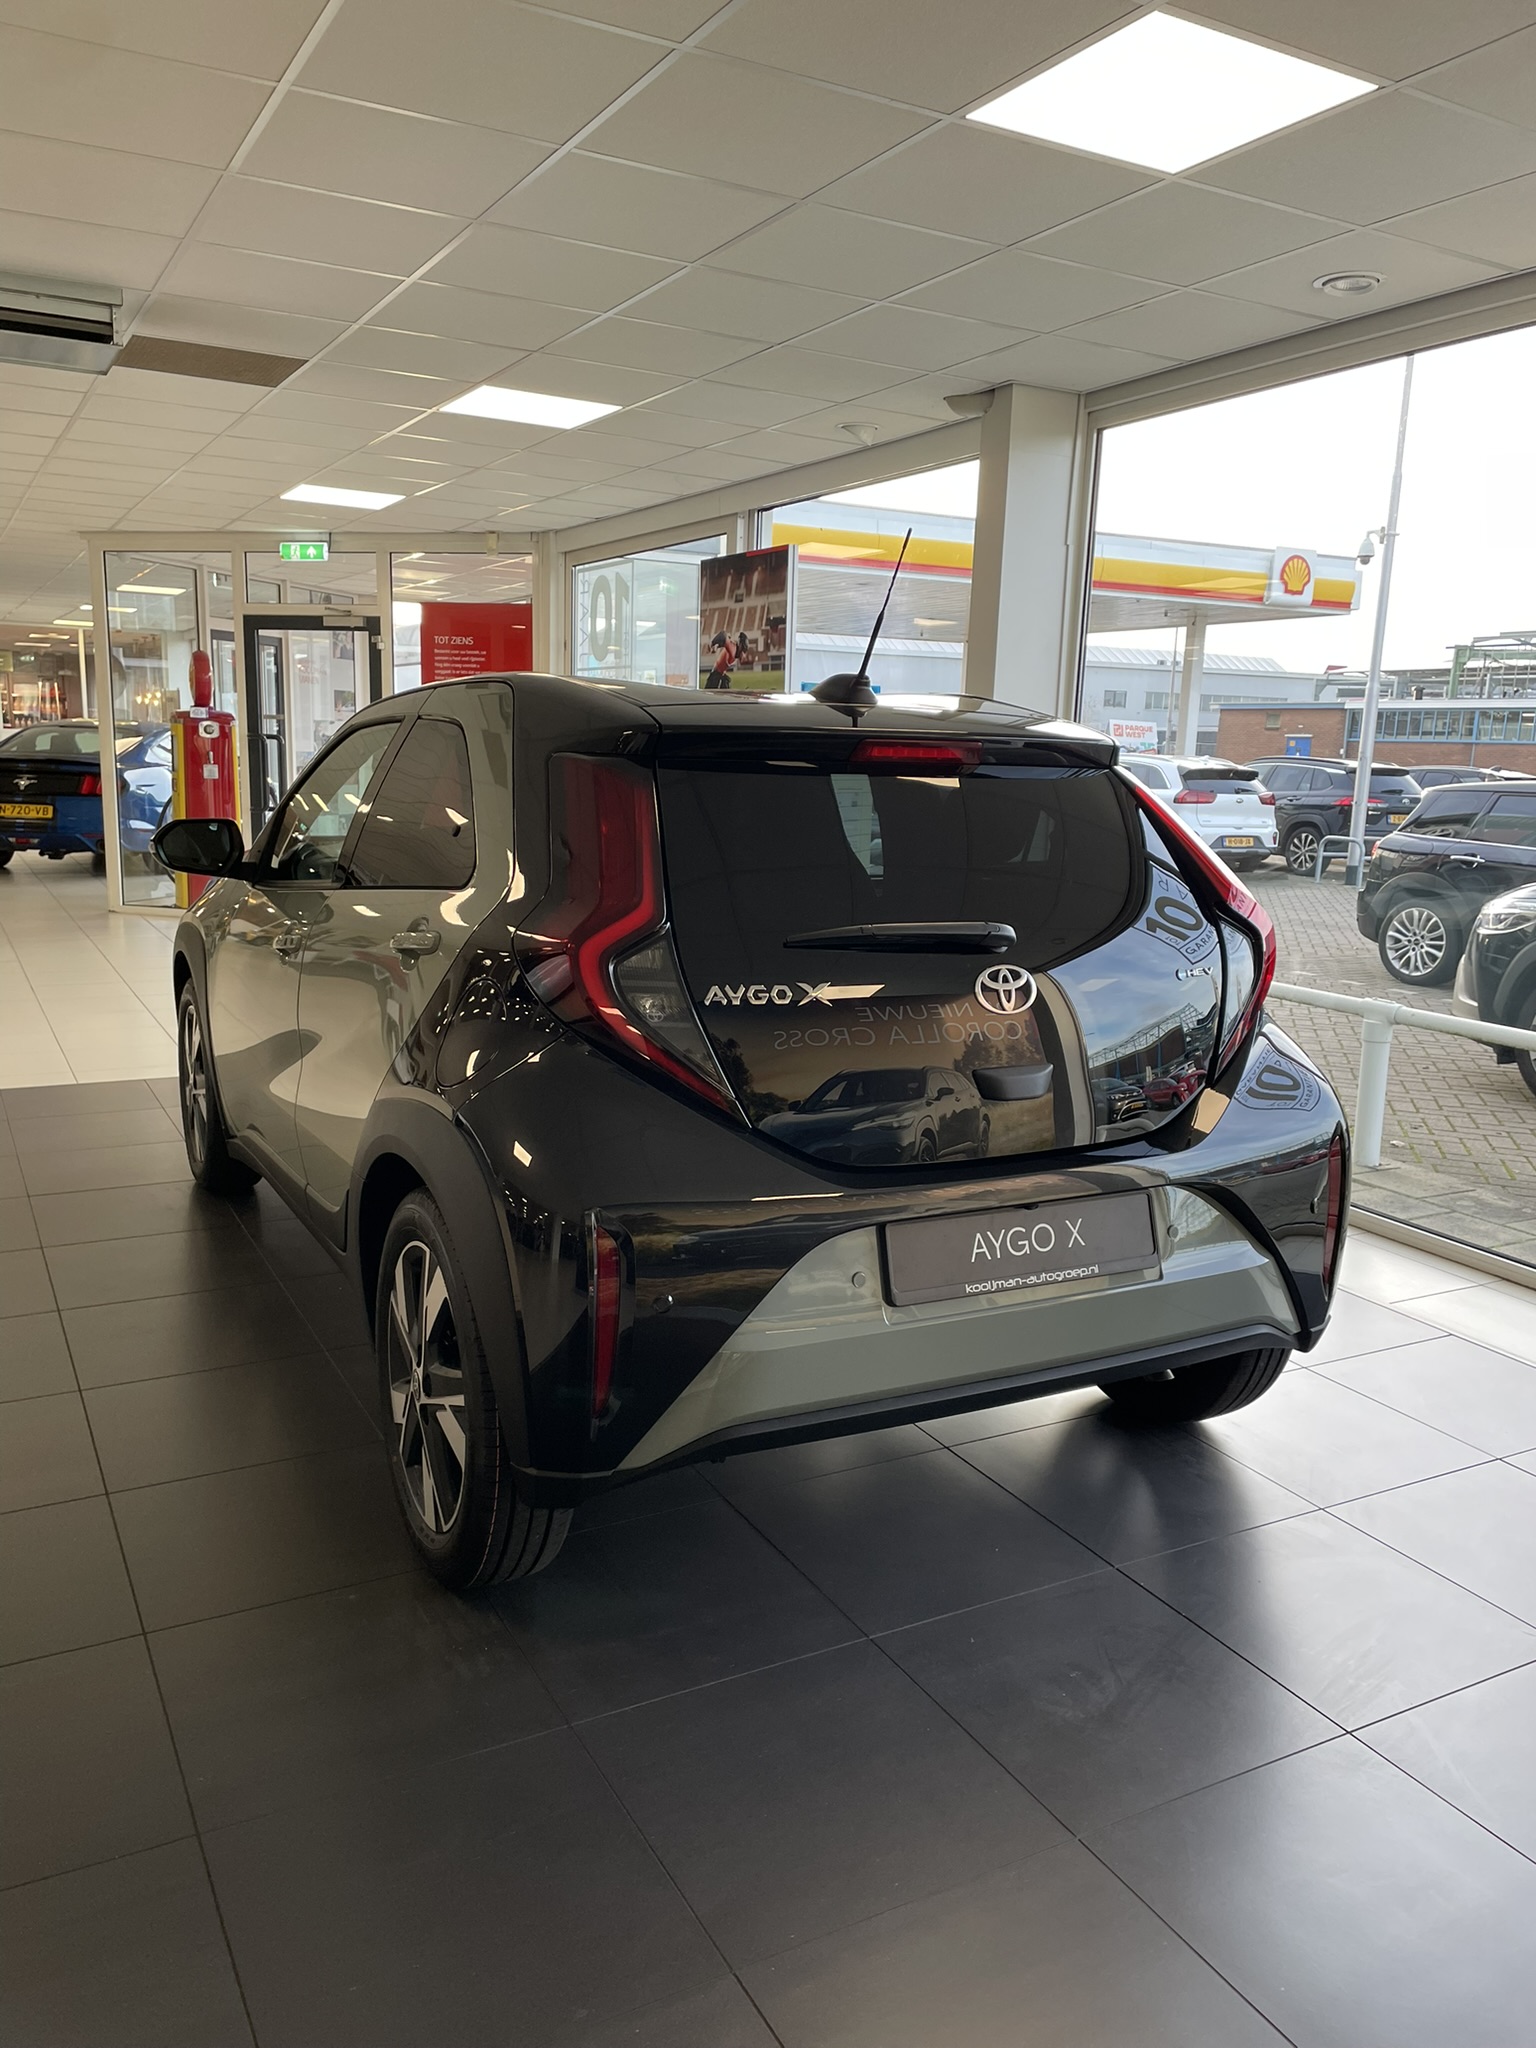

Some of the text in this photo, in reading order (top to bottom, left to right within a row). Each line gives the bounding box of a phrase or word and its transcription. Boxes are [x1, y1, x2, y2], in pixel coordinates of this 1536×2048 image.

[434, 636, 474, 645] TOT ZIENS
[1125, 725, 1153, 733] PARQUE
[1146, 896, 1203, 942] 10
[1187, 967, 1214, 977] HEV
[704, 984, 793, 1007] AYGO
[971, 1218, 1086, 1263] AYGO X
[965, 1264, 1099, 1294] kooijman-autogroep.nl
